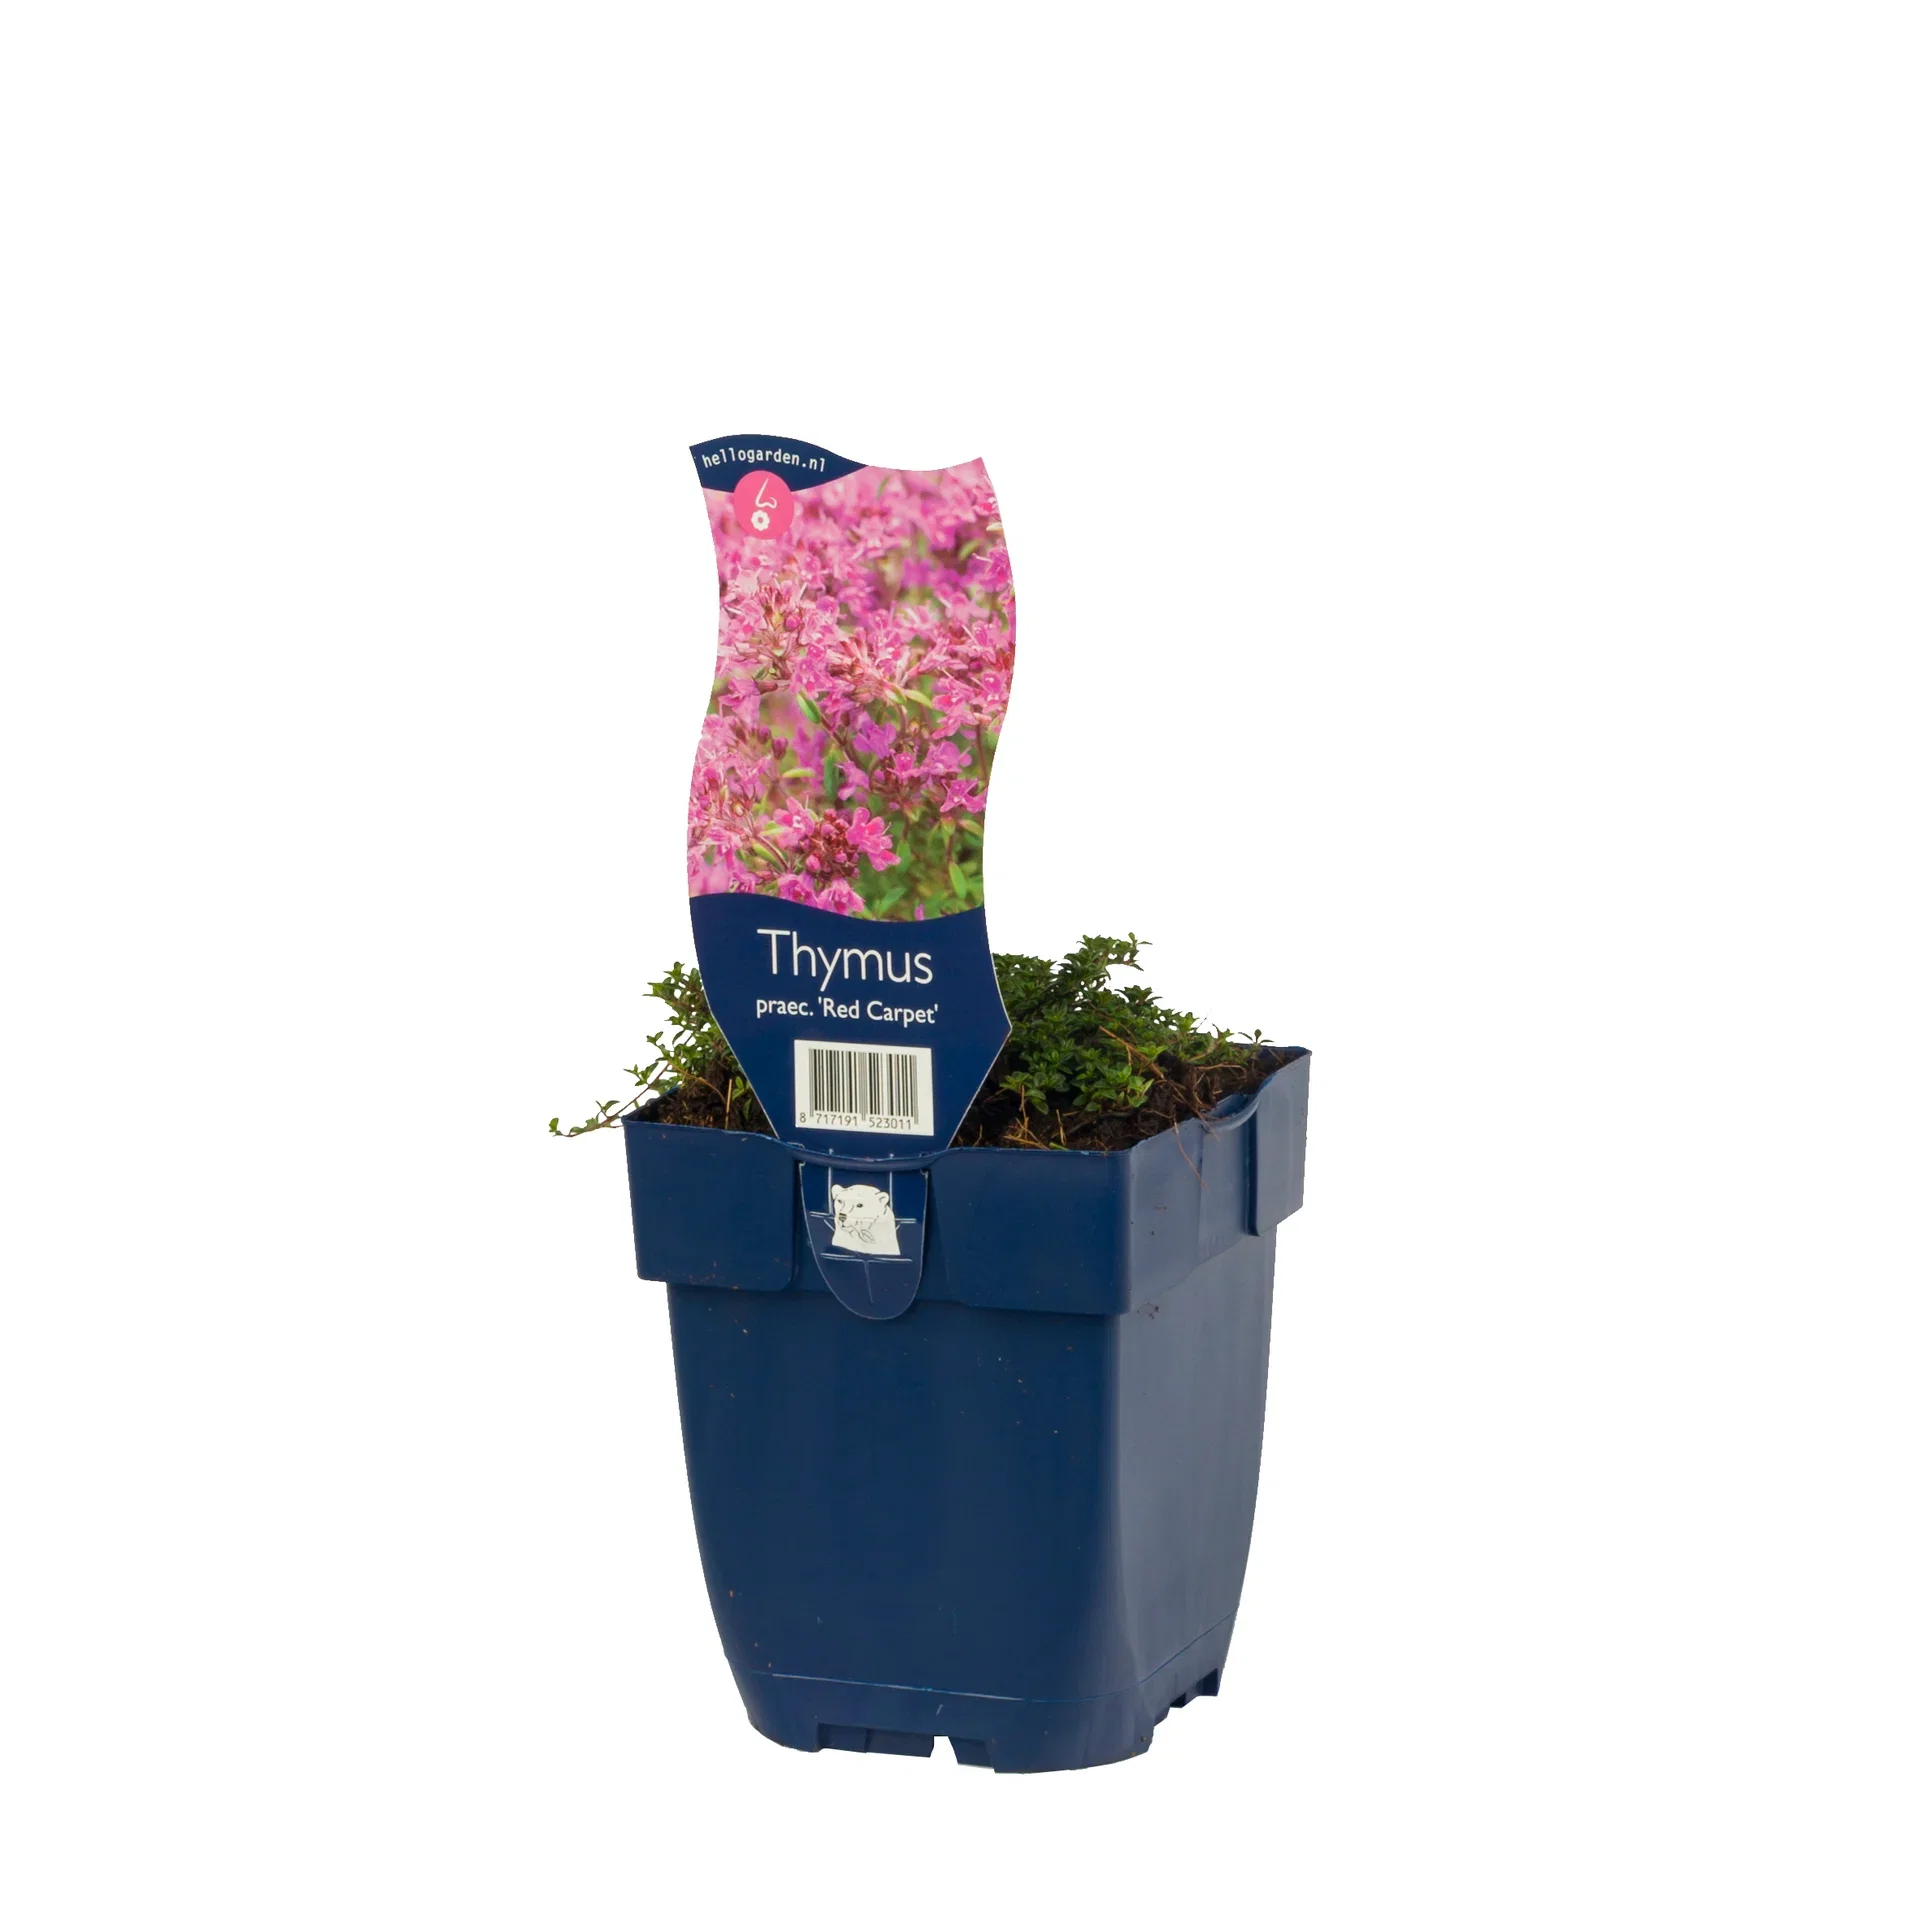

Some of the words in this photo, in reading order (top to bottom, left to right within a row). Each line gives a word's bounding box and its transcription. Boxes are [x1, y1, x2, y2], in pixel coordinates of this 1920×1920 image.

[702, 447, 826, 472] hellogarden.nl
[756, 928, 933, 992] Thymus
[756, 999, 814, 1019] praec.
[818, 996, 860, 1019] 'Red
[866, 1001, 939, 1028] Carpet'
[799, 1112, 807, 1124] 8
[815, 1113, 858, 1127] 717191
[868, 1117, 912, 1130] 523011
